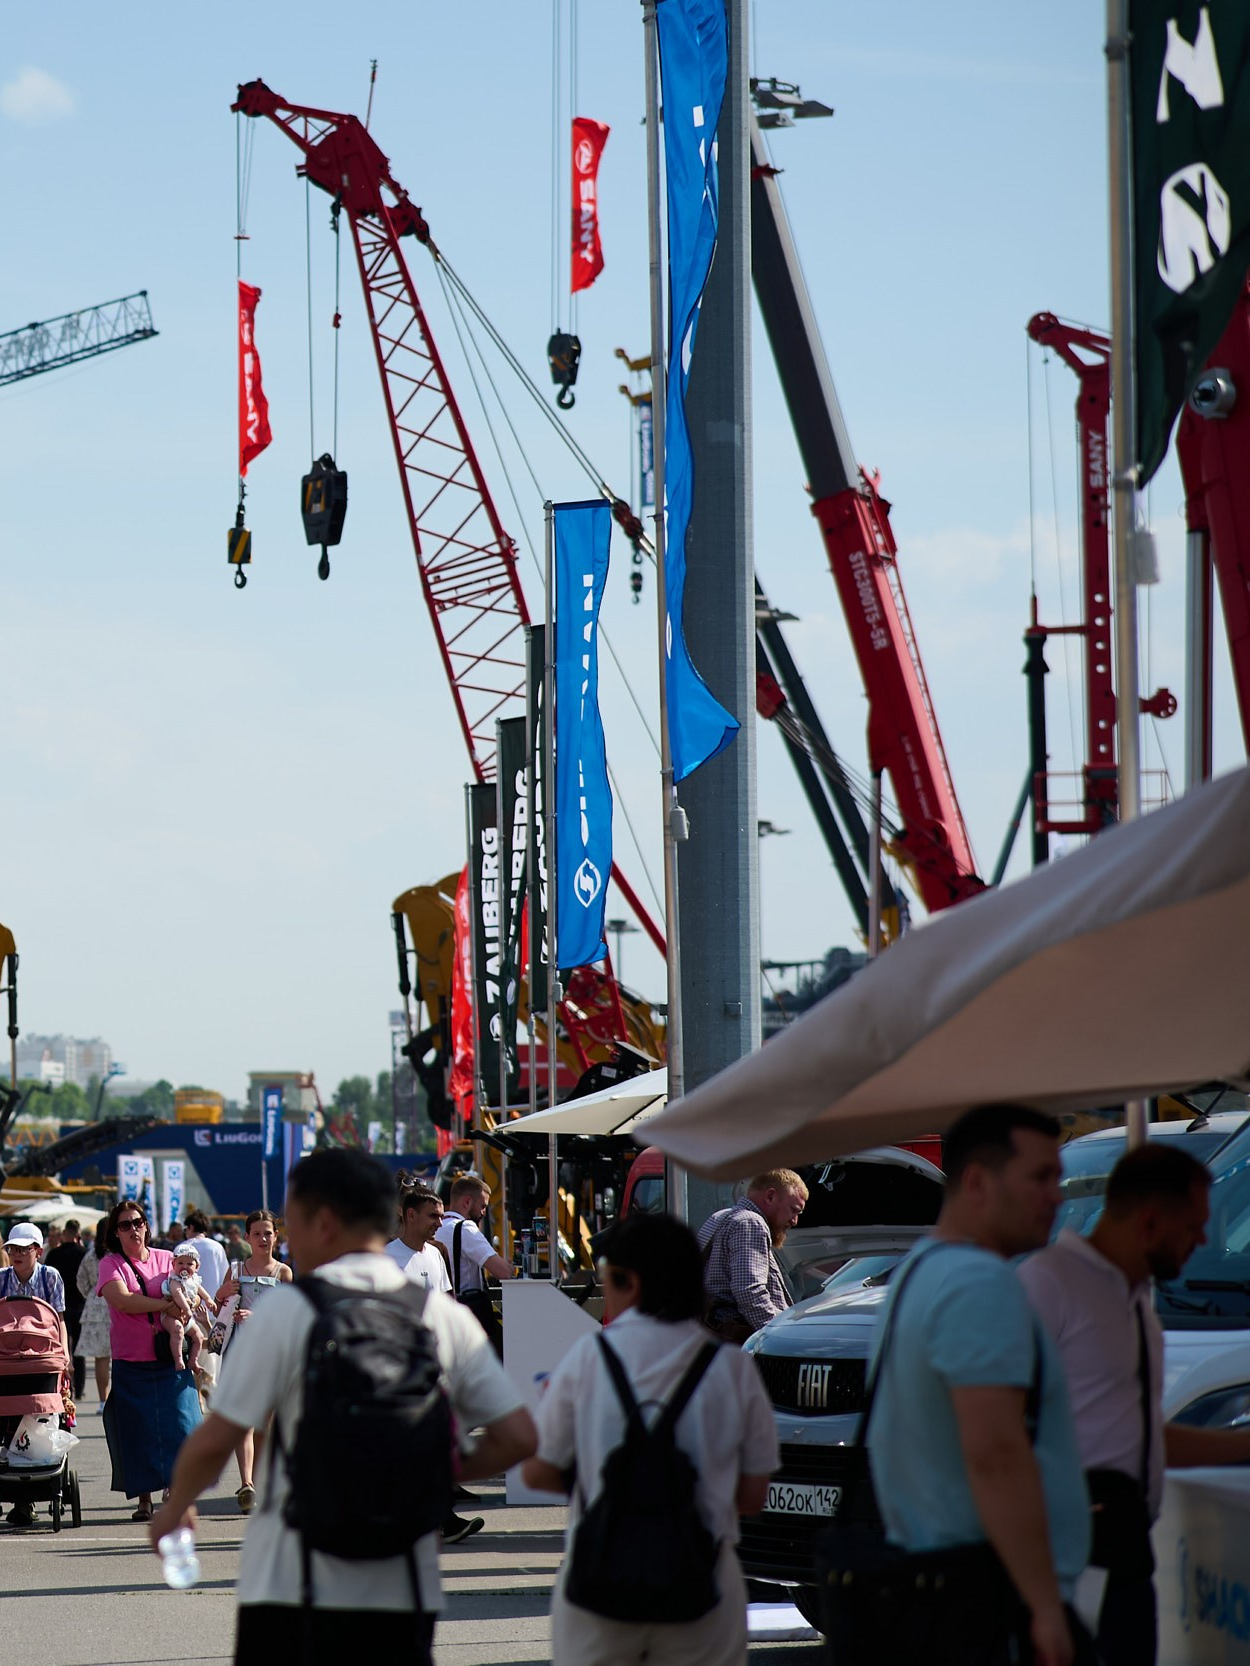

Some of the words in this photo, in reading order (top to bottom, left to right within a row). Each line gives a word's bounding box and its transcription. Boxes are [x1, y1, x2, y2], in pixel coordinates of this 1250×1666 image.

[1088, 429, 1104, 488] SANY
[797, 1364, 833, 1408] FIAT
[762, 1486, 814, 1513] 062OK
[816, 1487, 840, 1507] 142
